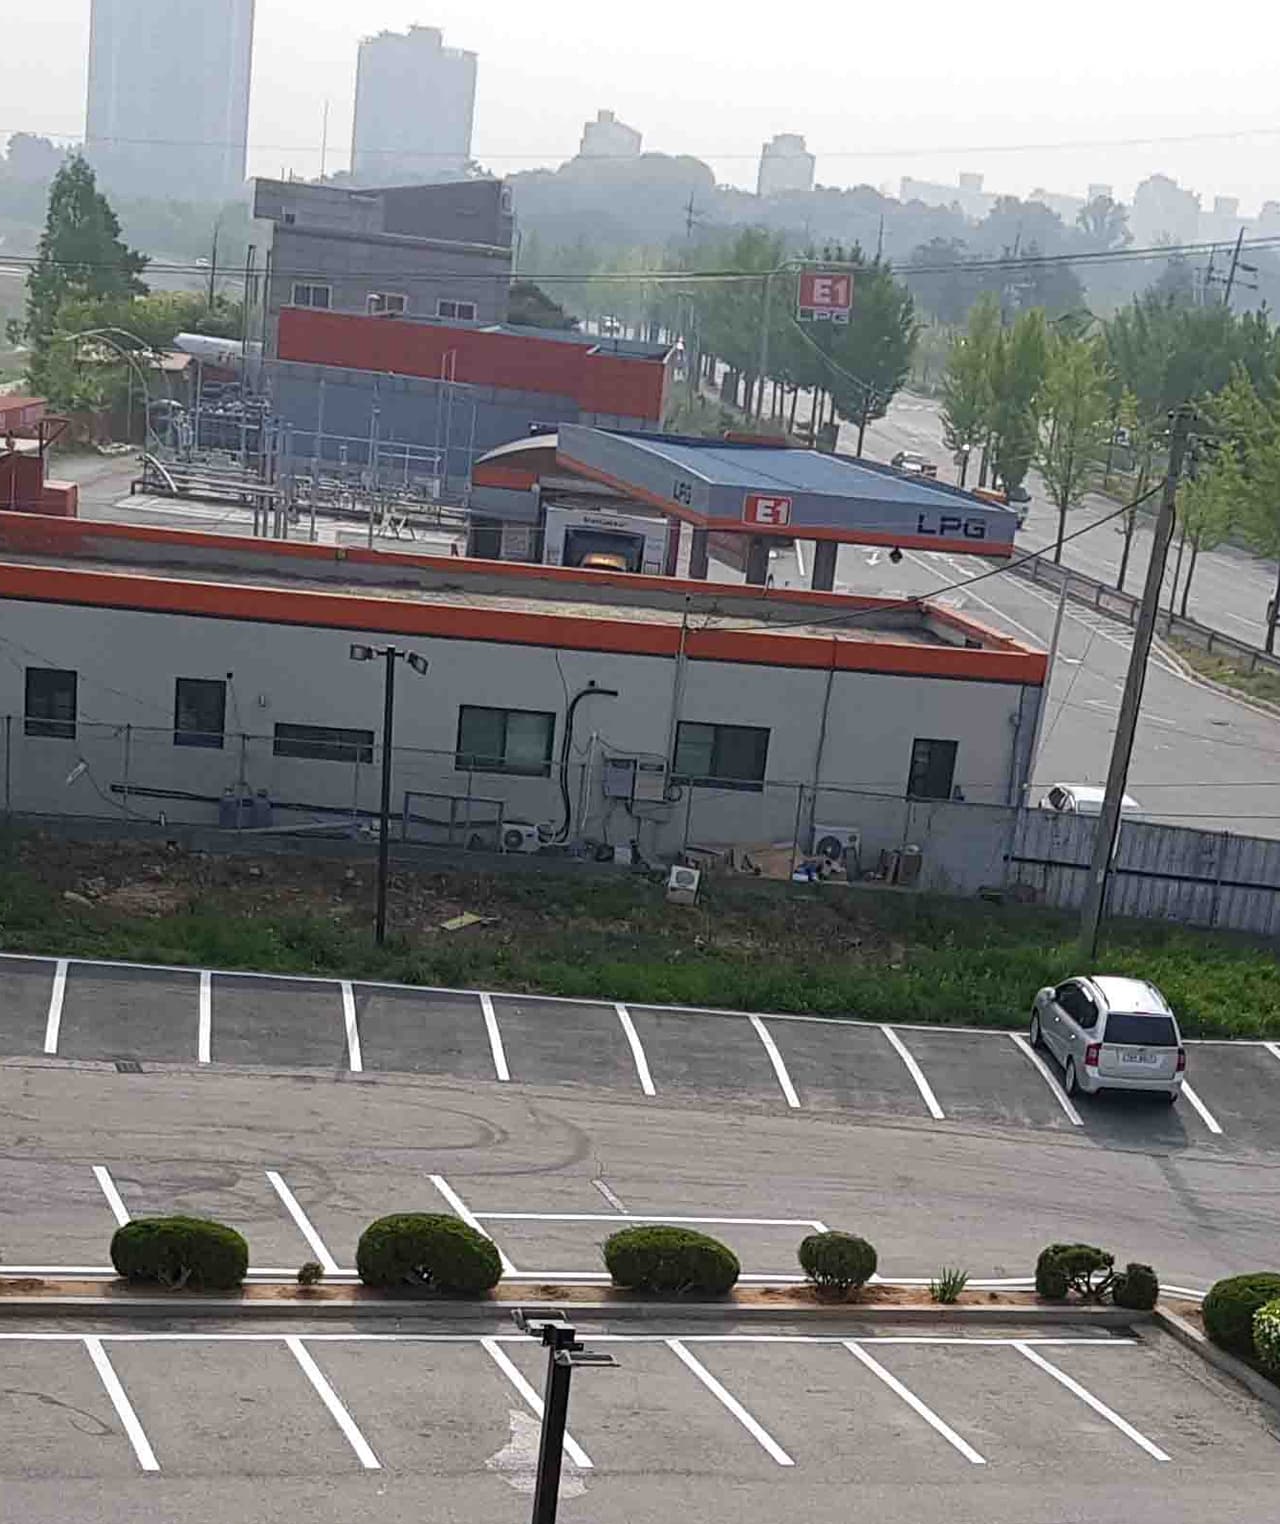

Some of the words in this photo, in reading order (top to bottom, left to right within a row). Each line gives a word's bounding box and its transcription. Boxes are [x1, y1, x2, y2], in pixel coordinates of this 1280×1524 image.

[814, 279, 848, 306] E1
[756, 497, 790, 525] E1
[918, 513, 986, 539] LPG
